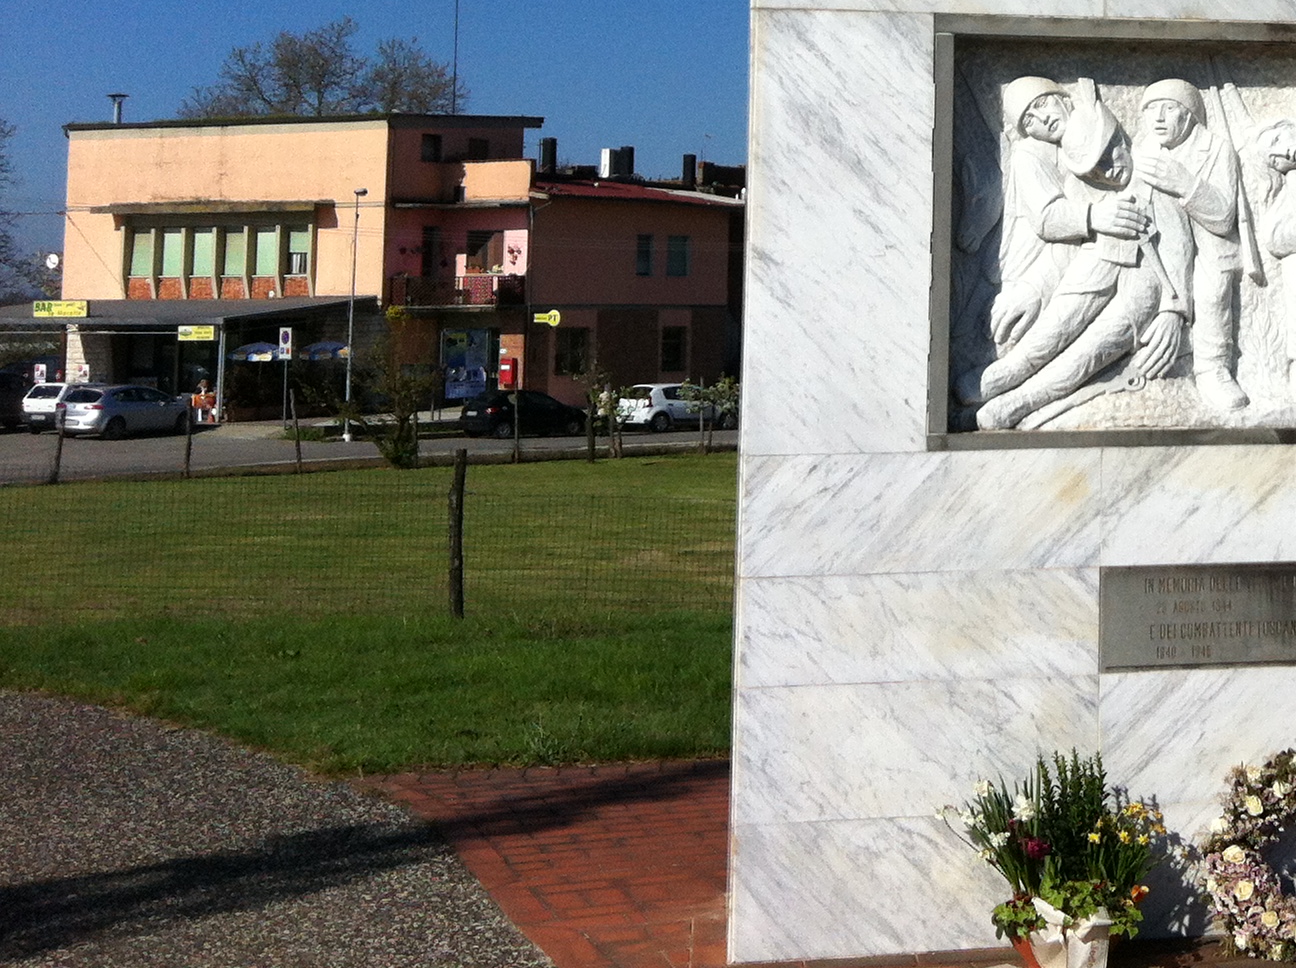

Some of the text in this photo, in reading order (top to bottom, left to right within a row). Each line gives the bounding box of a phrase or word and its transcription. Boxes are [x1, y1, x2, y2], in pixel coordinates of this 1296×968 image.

[34, 302, 53, 312] BAR
[1145, 578, 1154, 593] IN
[1159, 577, 1205, 593] MEMORIA
[1160, 623, 1177, 640] DEI
